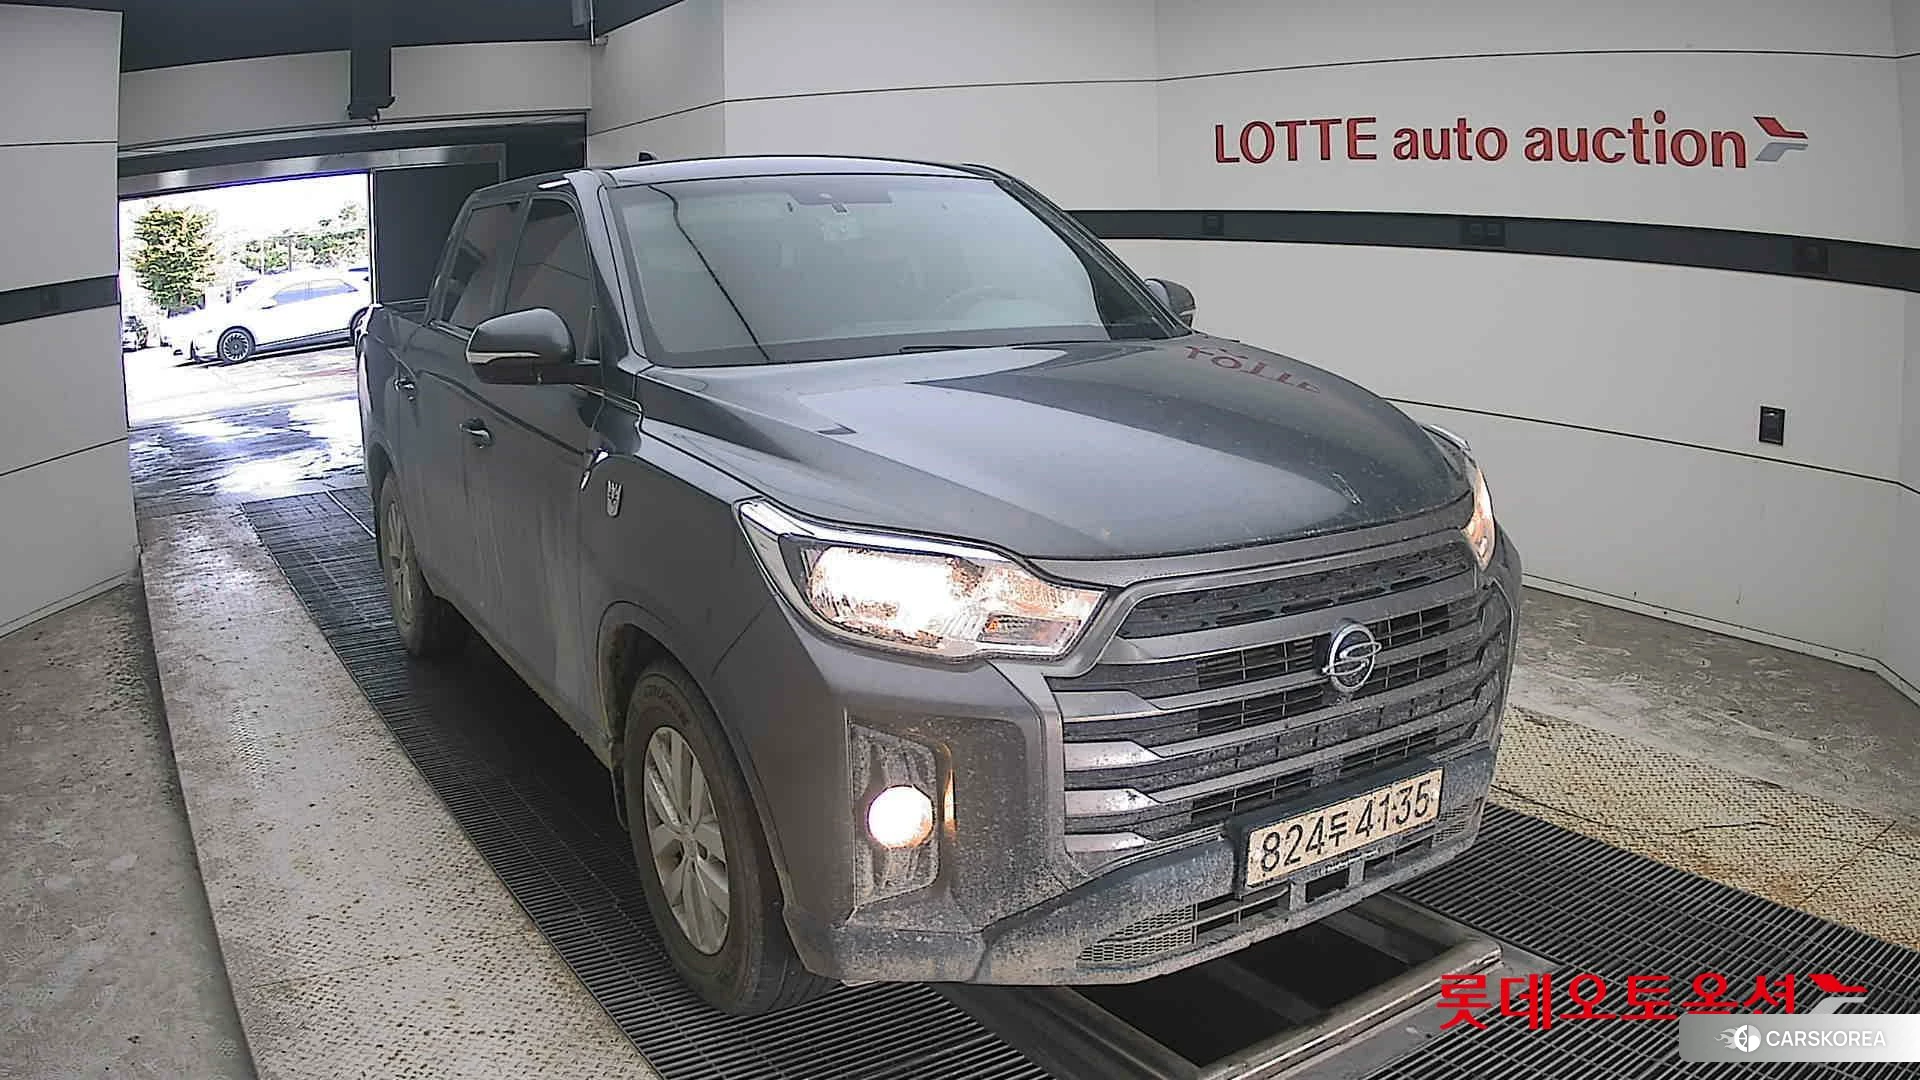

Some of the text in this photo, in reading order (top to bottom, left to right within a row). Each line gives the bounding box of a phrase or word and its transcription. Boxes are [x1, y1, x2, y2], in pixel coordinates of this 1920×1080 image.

[1215, 110, 1747, 168] LOTTE auto auction
